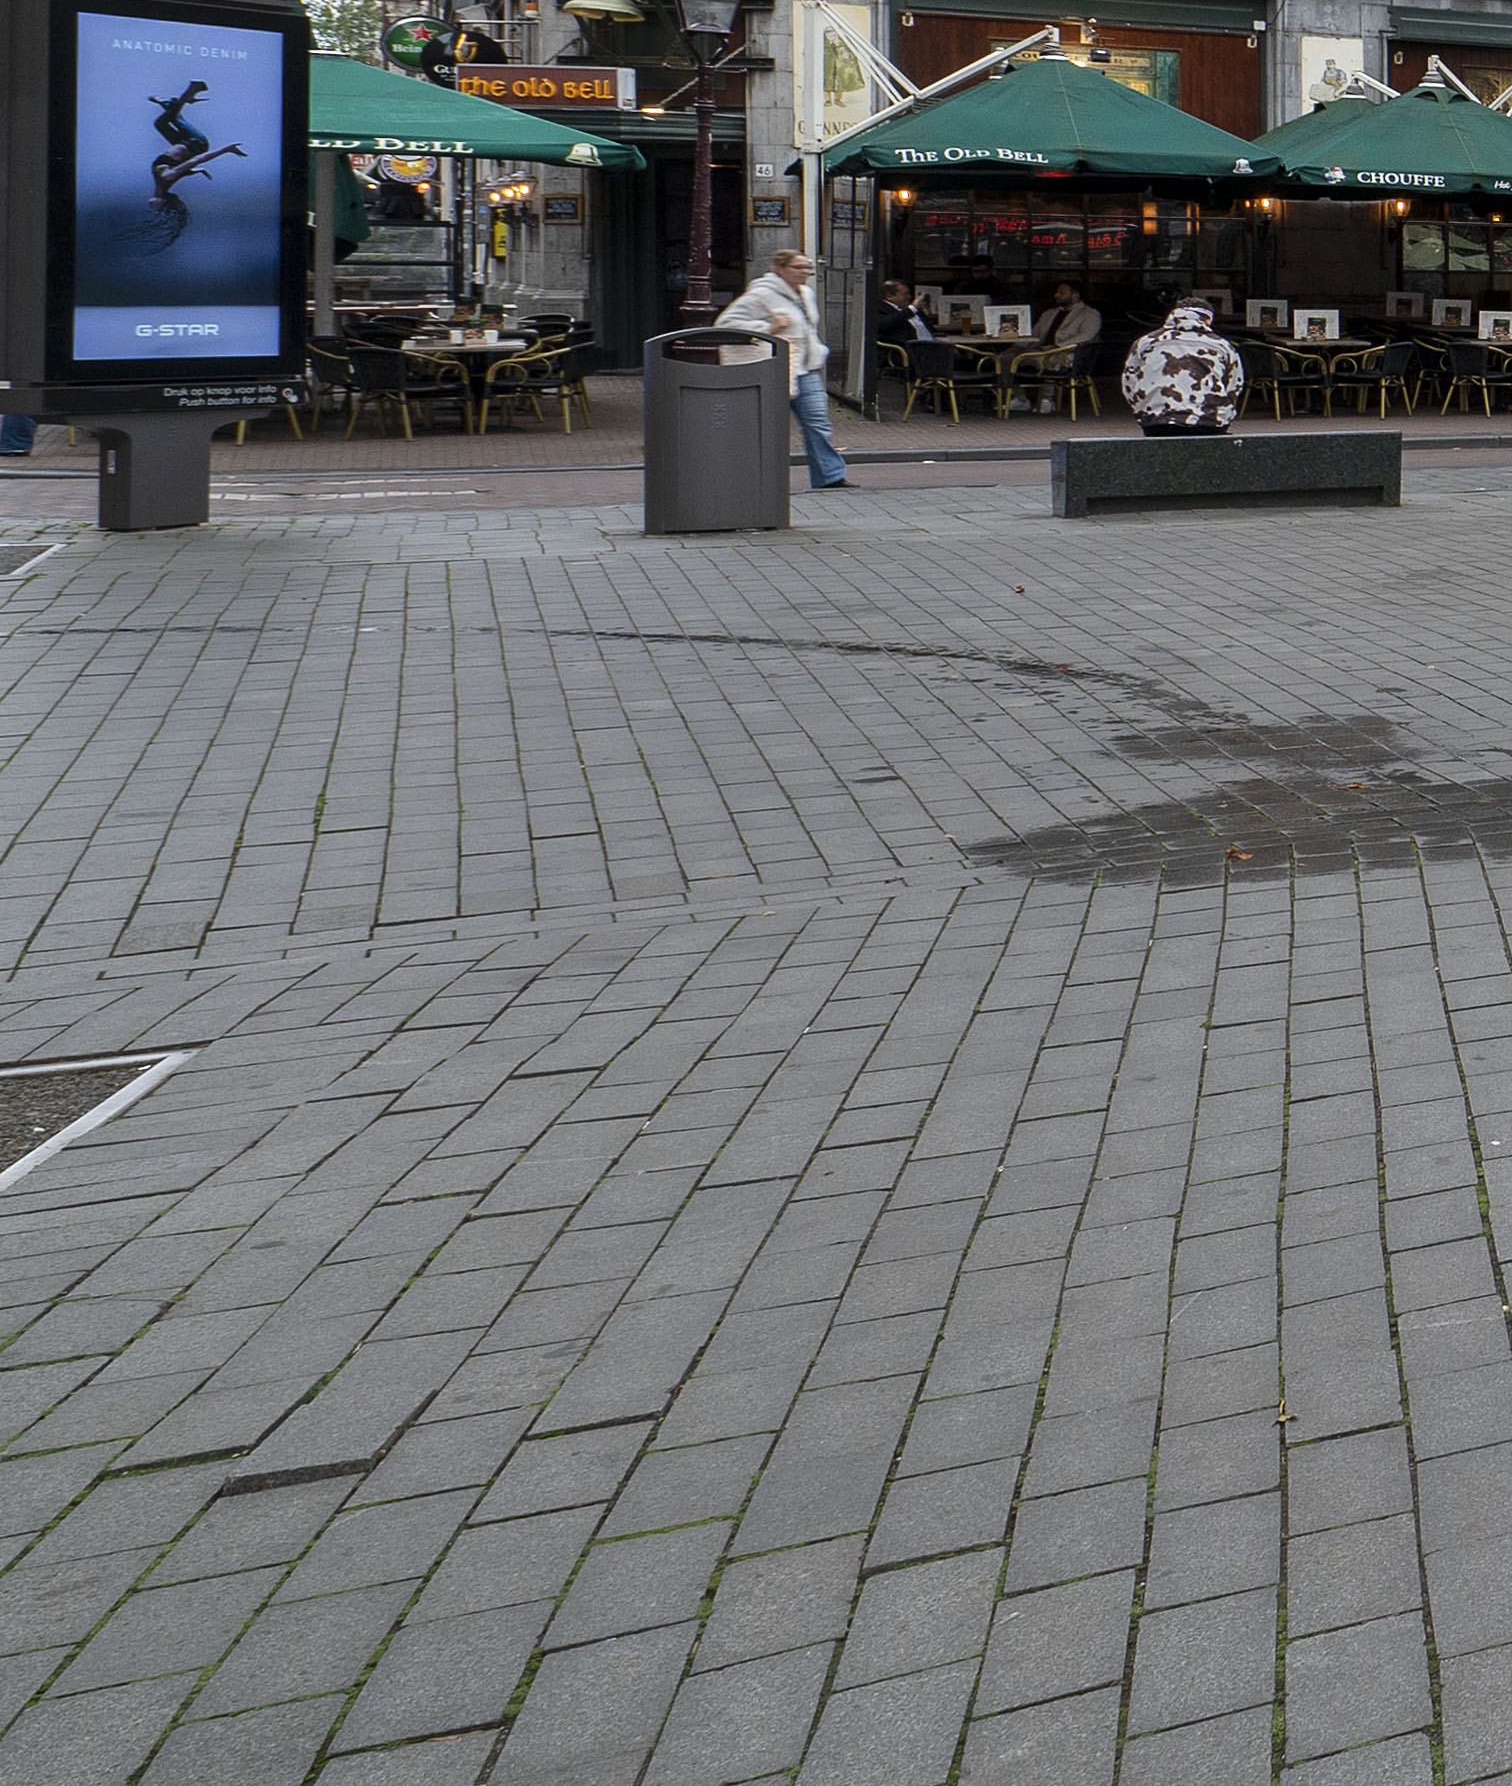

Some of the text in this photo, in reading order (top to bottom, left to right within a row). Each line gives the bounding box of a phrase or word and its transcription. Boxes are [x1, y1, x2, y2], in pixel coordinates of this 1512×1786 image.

[112, 38, 248, 60] ANATOMIC DENIM
[392, 44, 422, 53] Hein
[757, 166, 771, 176] 46
[1357, 171, 1446, 188] CHOUFFE
[135, 324, 219, 337] G-STAR
